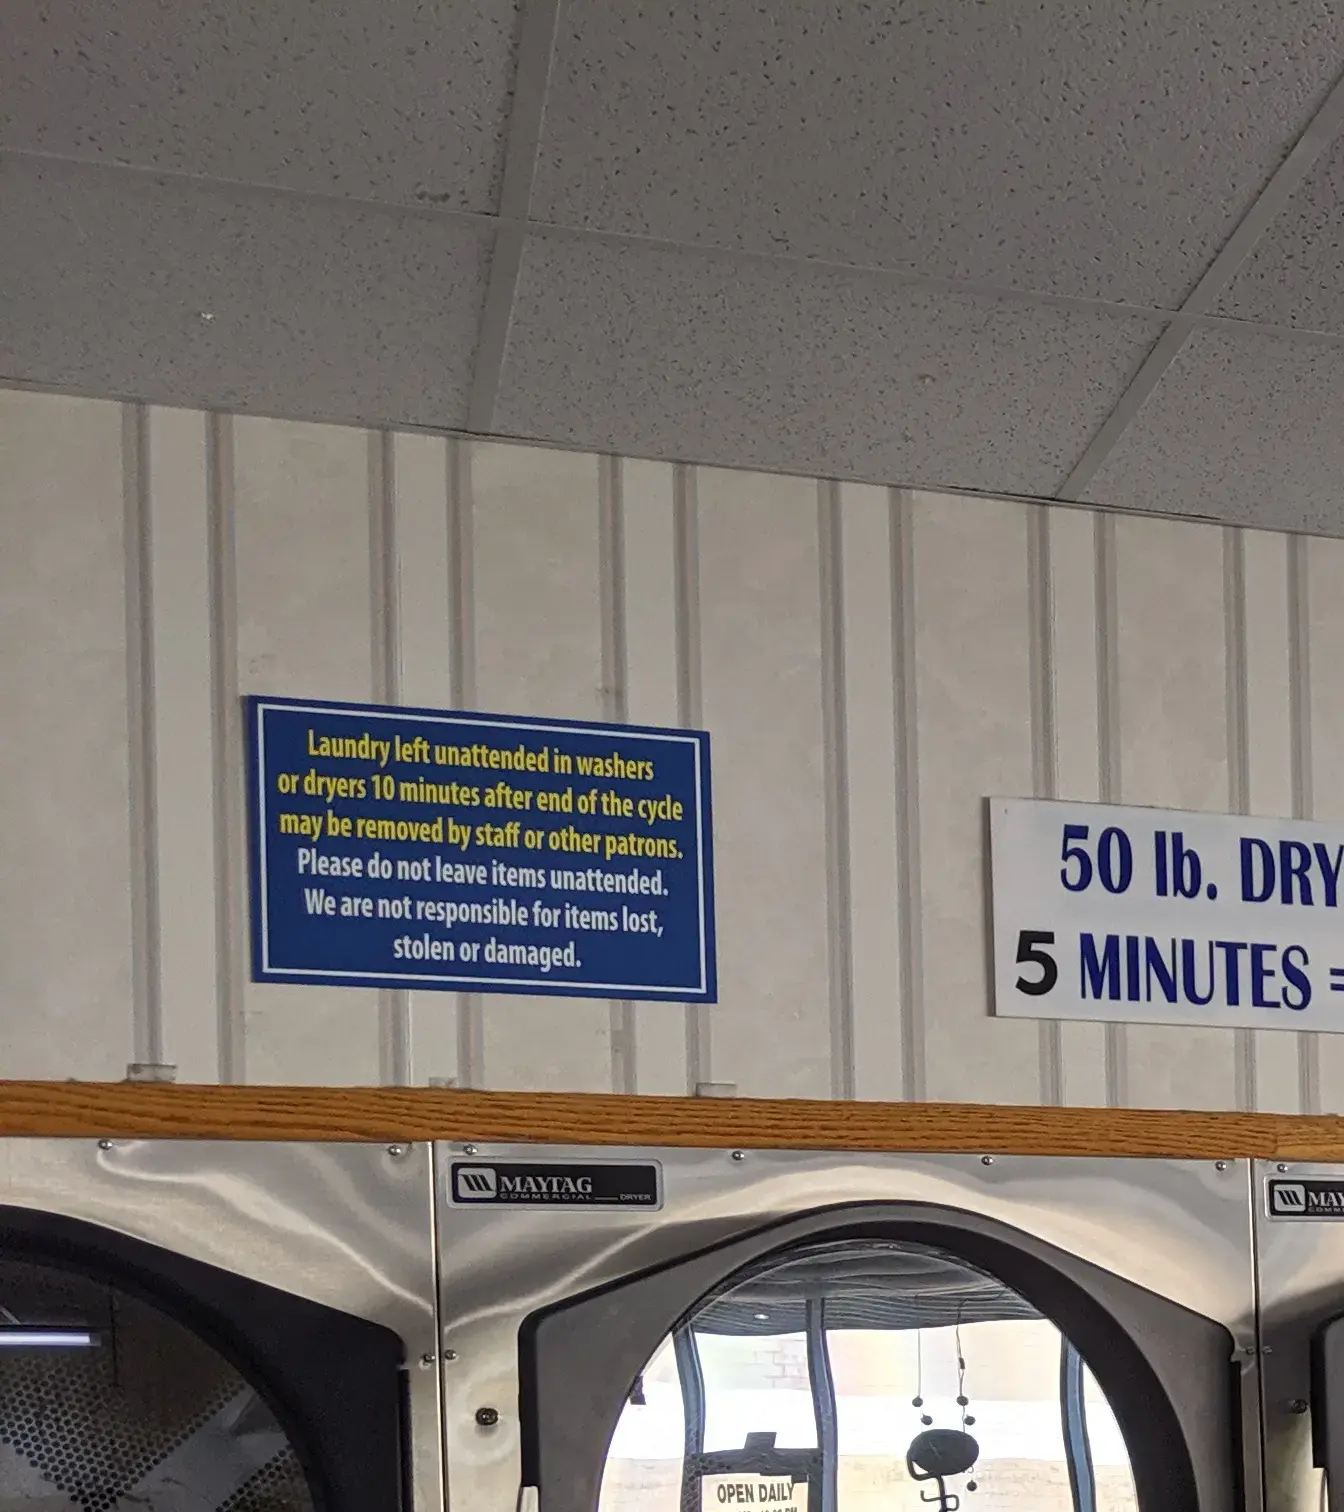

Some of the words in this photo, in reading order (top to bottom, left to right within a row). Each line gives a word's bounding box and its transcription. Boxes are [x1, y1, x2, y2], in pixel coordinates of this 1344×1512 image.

[308, 729, 390, 767] Laundry
[395, 735, 429, 765] left
[435, 740, 549, 773] unattended
[553, 748, 572, 774] in
[577, 752, 653, 781] washers
[277, 773, 300, 795] or
[304, 768, 366, 803] dryers
[371, 775, 394, 800] 10
[399, 779, 480, 807] minutes
[484, 785, 531, 810] after
[536, 790, 572, 813] end
[577, 791, 600, 815] of
[602, 796, 633, 817] the
[638, 796, 683, 824] cycle
[280, 813, 322, 840] may
[327, 815, 351, 837] be
[357, 818, 443, 844] removed
[448, 821, 471, 850] by
[476, 824, 520, 847] staff
[525, 830, 544, 850] or
[549, 829, 600, 852] other
[605, 834, 683, 861] patrons.
[298, 848, 362, 878] Please
[368, 852, 392, 879] do
[397, 856, 430, 882] not
[436, 855, 487, 885] leave
[492, 859, 546, 887] items
[550, 864, 668, 896] unattended.
[1061, 824, 1132, 894] 50
[1155, 831, 1217, 900] lb.
[305, 887, 336, 915] We
[341, 896, 373, 917] are
[378, 894, 411, 919] not
[417, 896, 528, 928] responsible
[532, 901, 560, 928] for
[564, 904, 618, 931] items
[623, 906, 664, 937] lost,
[394, 935, 454, 961] stolen
[459, 942, 479, 962] or
[484, 943, 581, 973] damaged.
[1015, 930, 1058, 995] 5
[1079, 933, 1312, 1011] MINUTES
[501, 1176, 592, 1193] MAYTAG
[717, 1484, 754, 1503] OPEN
[758, 1482, 794, 1502] DAILY
